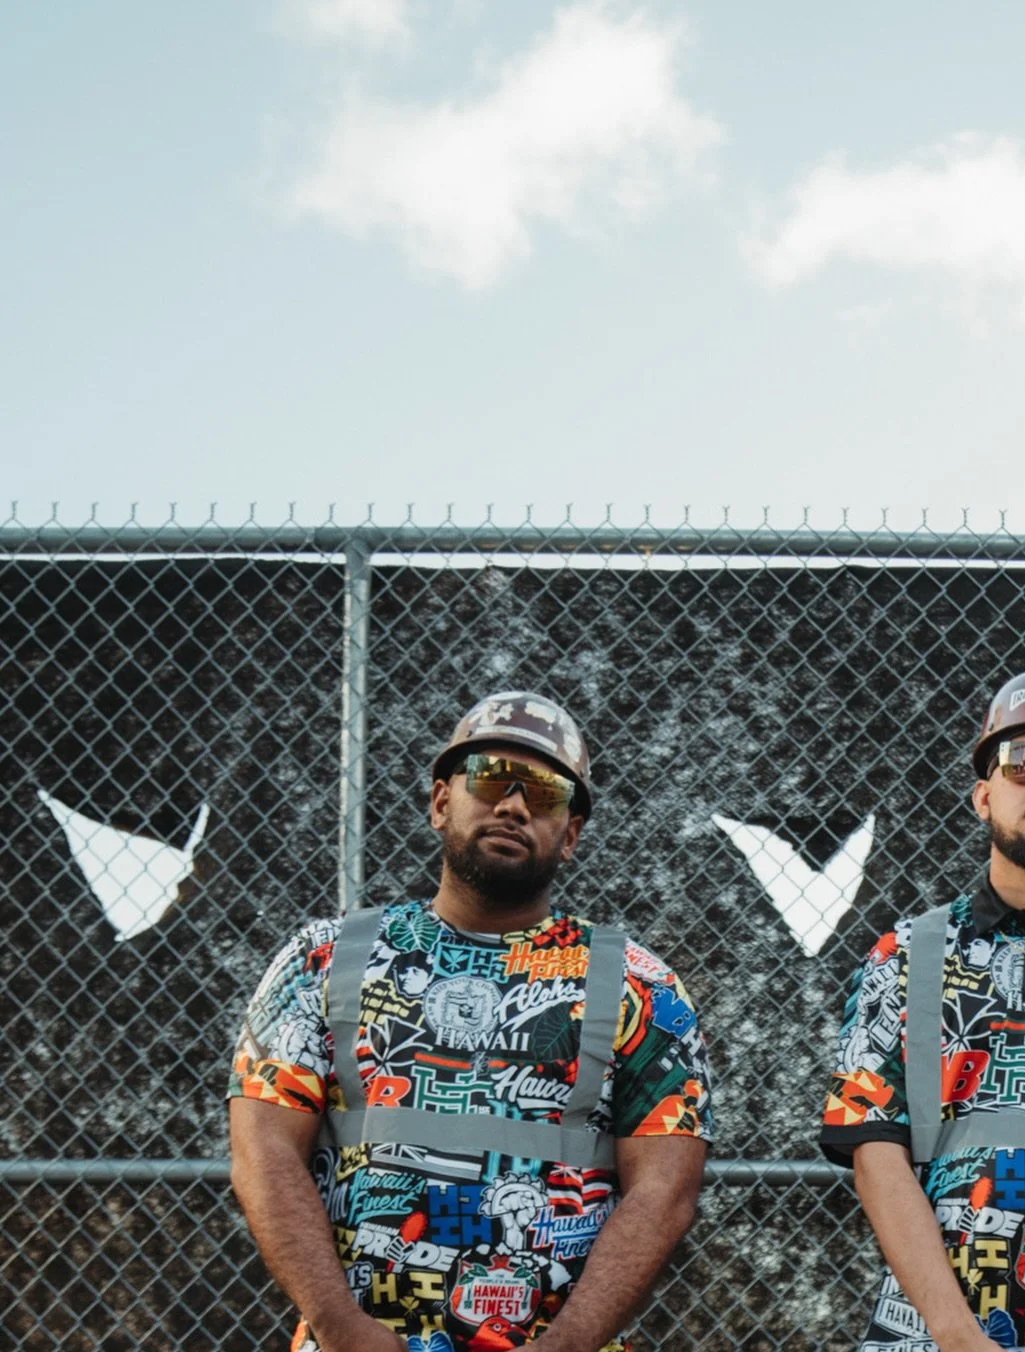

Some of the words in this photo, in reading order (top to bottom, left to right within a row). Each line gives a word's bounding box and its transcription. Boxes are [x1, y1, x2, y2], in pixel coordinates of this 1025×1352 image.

[494, 976, 586, 1030] Aloha
[434, 1026, 530, 1052] HAWAII
[473, 1284, 525, 1299] HAWAII'S
[473, 1298, 521, 1316] FINEST
